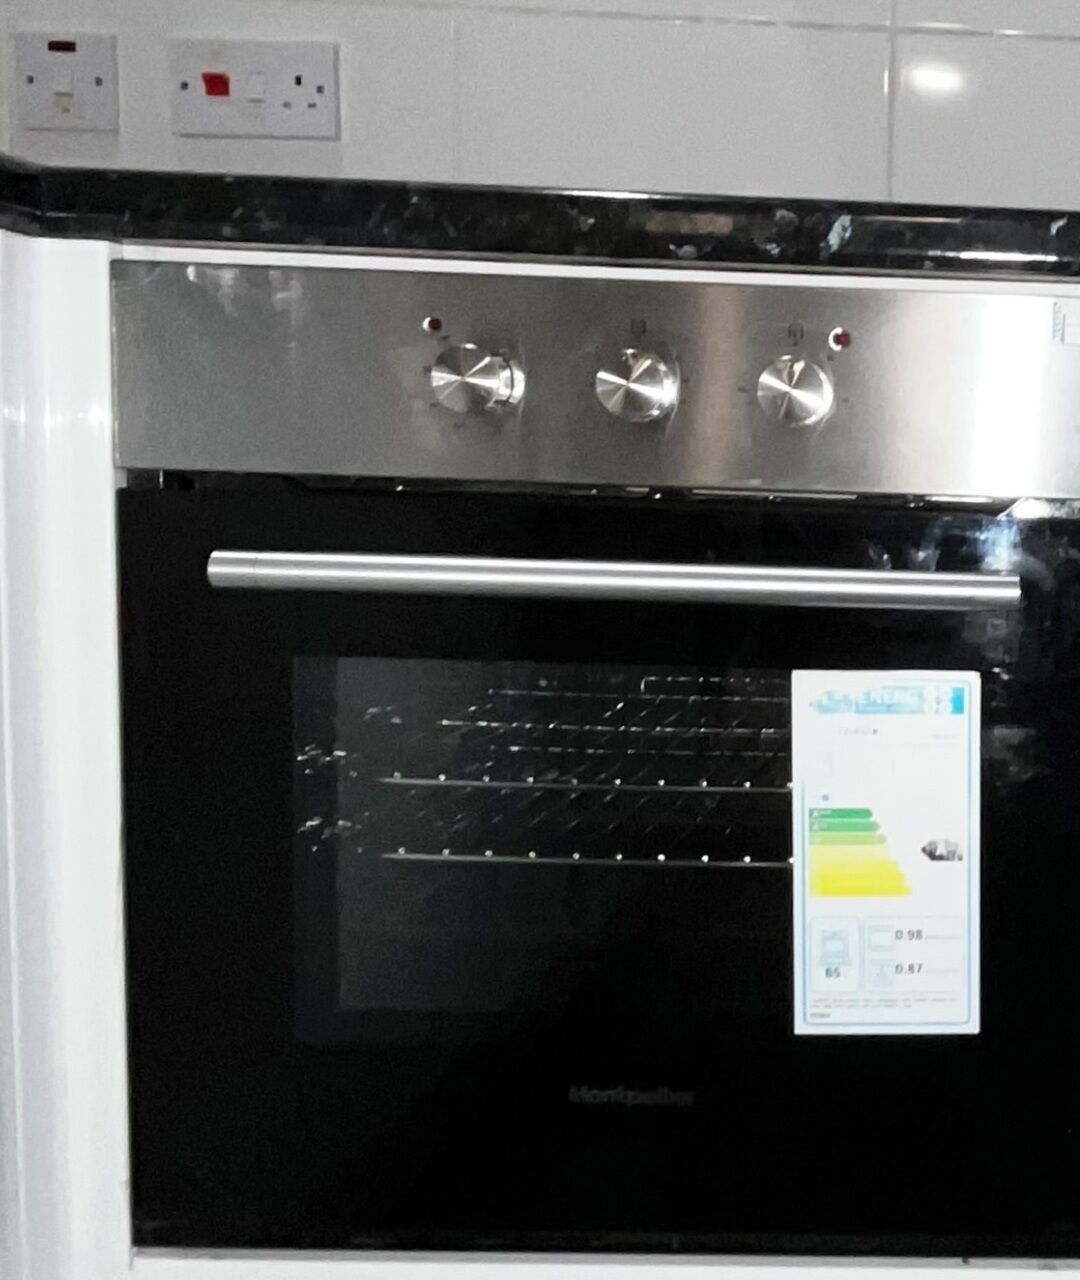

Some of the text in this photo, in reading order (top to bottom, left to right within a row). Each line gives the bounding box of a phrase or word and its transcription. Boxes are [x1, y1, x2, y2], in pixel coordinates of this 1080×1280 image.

[895, 929, 923, 940] 0.98
[825, 967, 841, 978] 65
[895, 963, 923, 974] 0.87
[568, 1085, 695, 1107] Montpll
